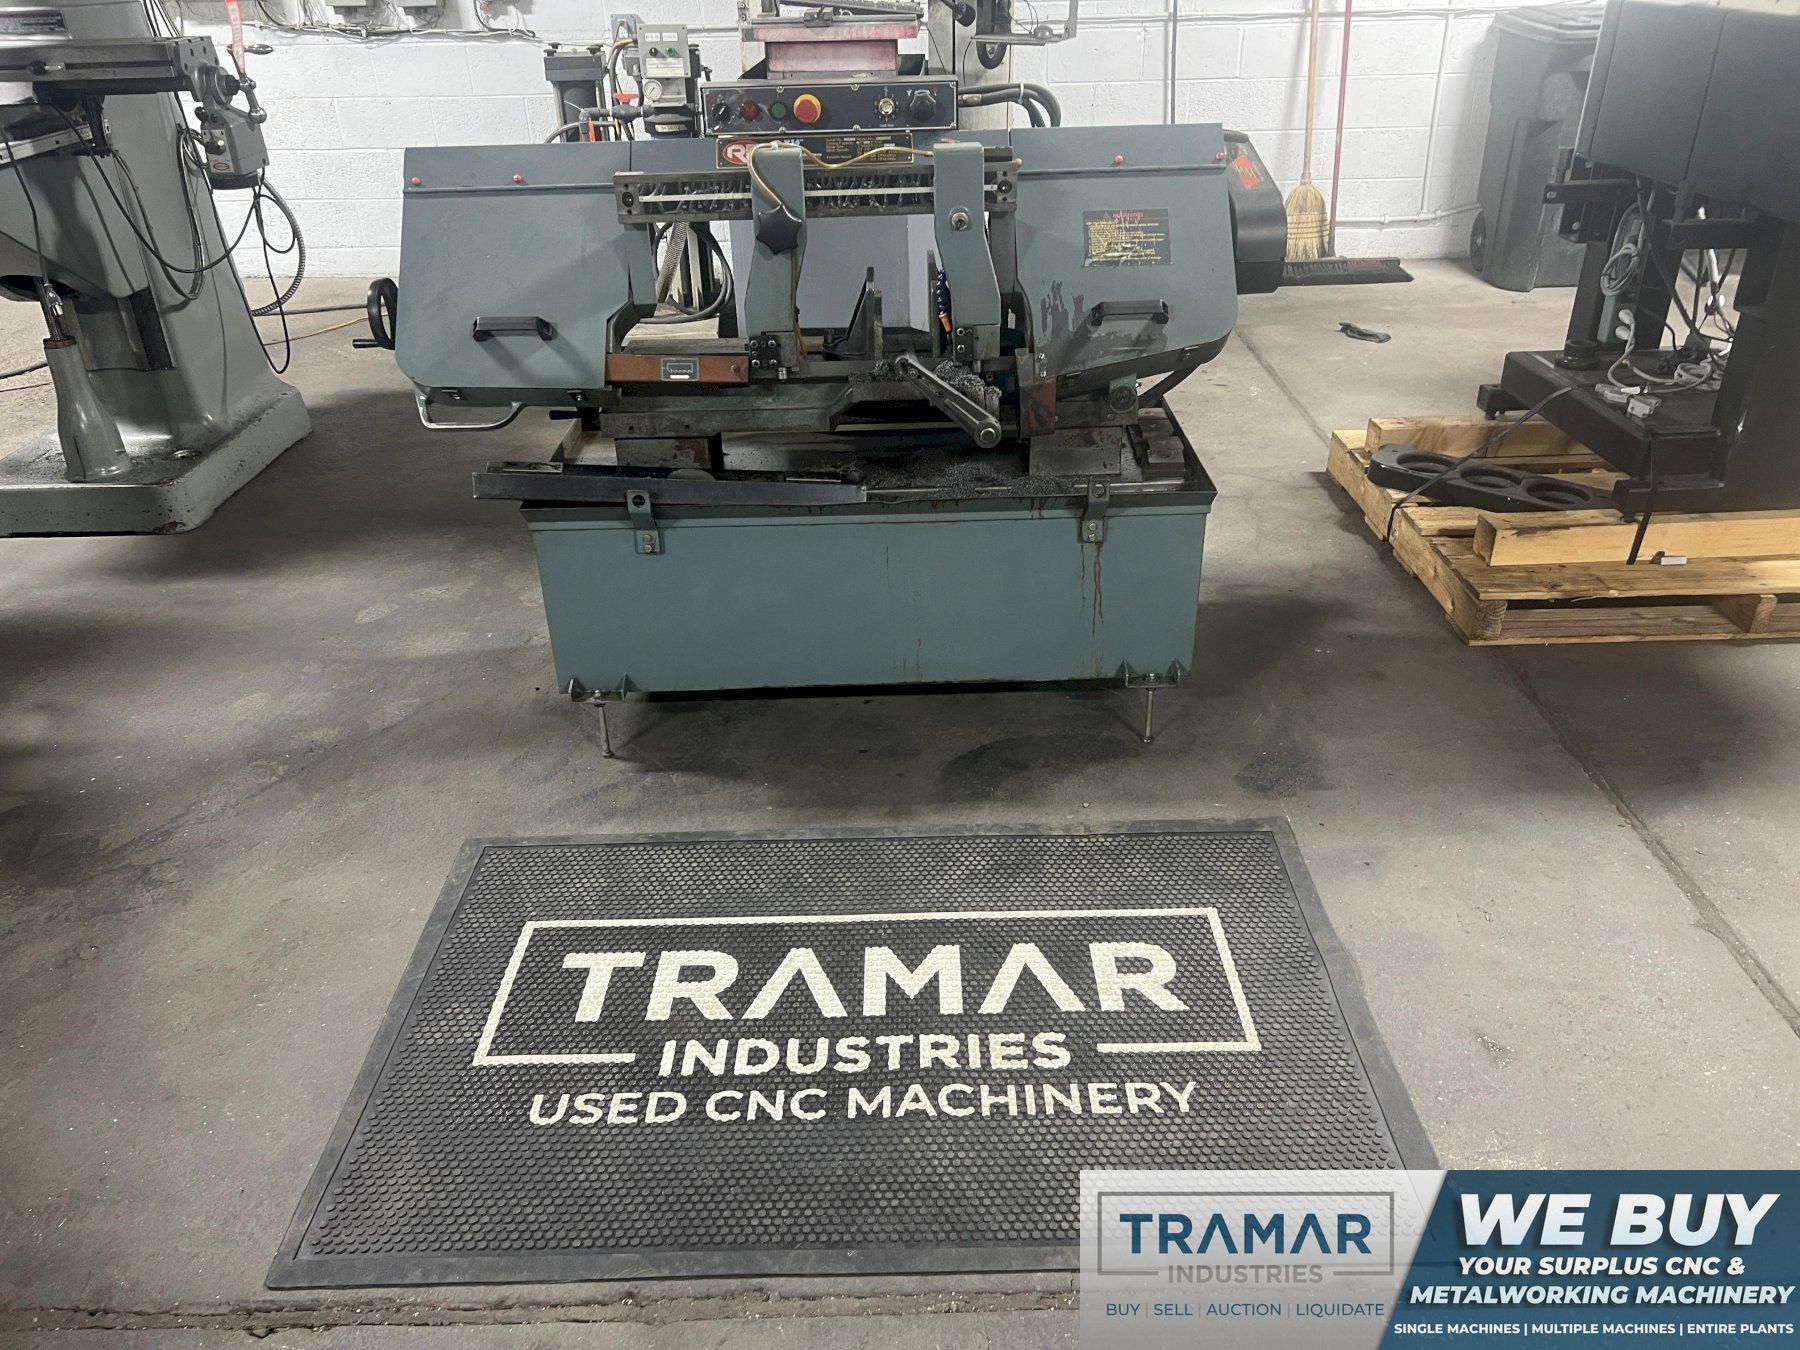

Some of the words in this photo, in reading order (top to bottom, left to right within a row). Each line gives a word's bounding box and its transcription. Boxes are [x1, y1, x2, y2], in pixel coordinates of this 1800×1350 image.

[561, 941, 1189, 1022] TRAMAR
[658, 1031, 1071, 1078] INDUSTRIES
[528, 1091, 686, 1127] USED
[706, 1088, 827, 1123] CNC
[846, 1081, 1198, 1120] MACHINERY
